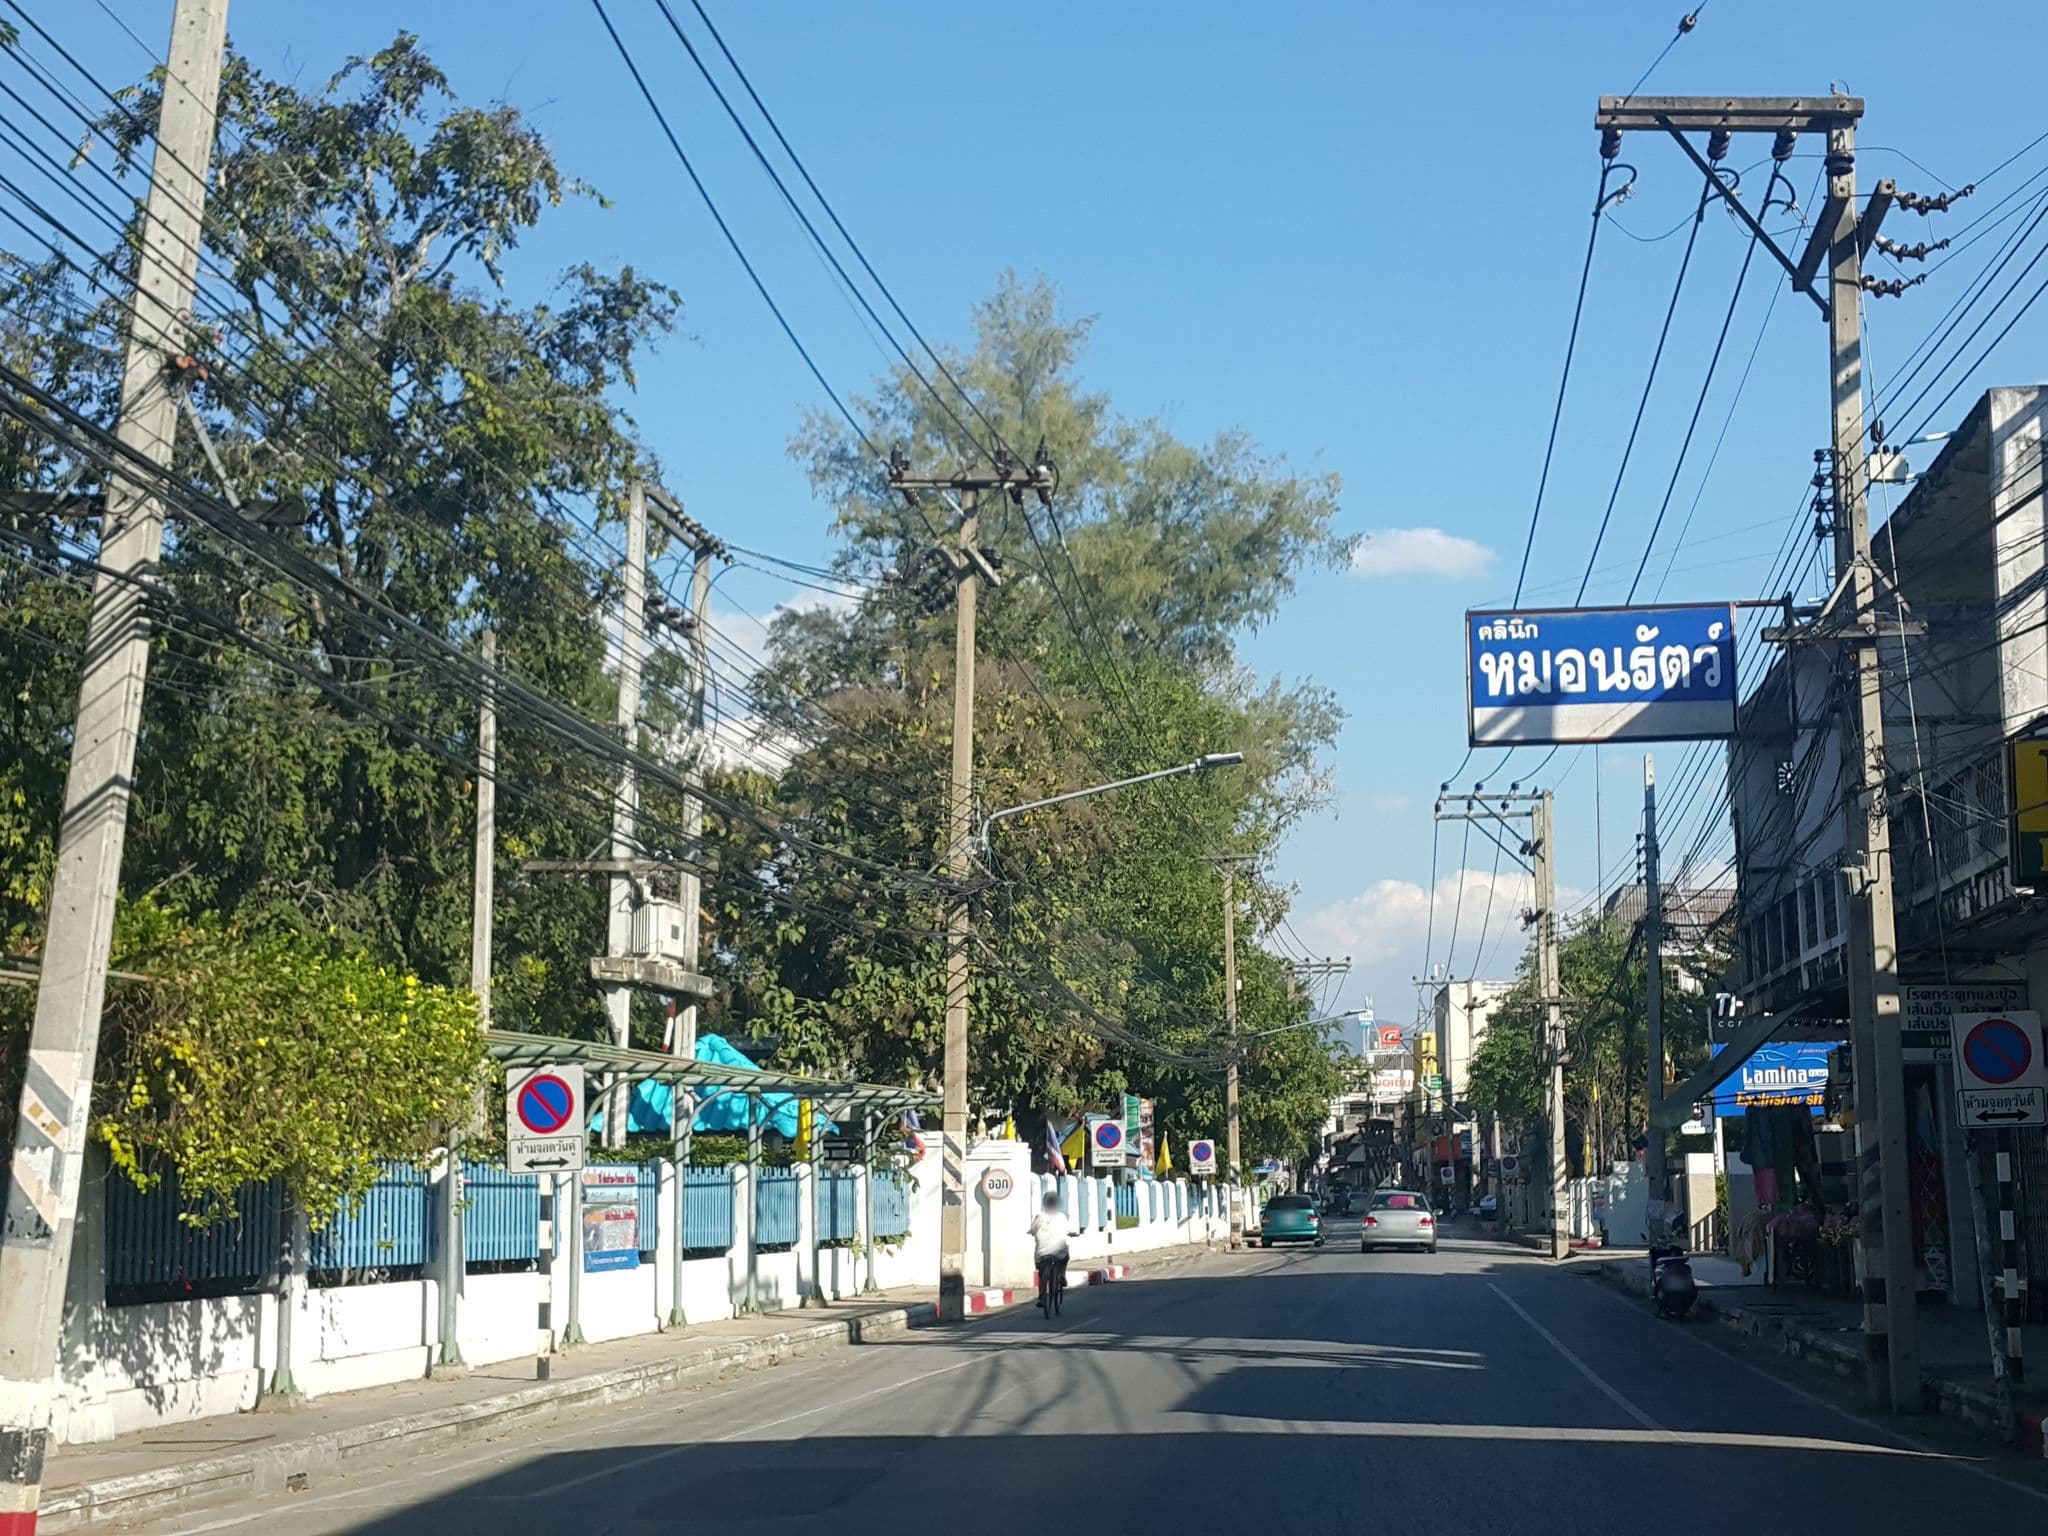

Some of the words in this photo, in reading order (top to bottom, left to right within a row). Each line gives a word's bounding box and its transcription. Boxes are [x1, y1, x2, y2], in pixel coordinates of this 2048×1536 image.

[1478, 618, 1538, 641] คลินิก
[1743, 1065, 1808, 1084] Lamina
[988, 1178, 1009, 1190] ออก
